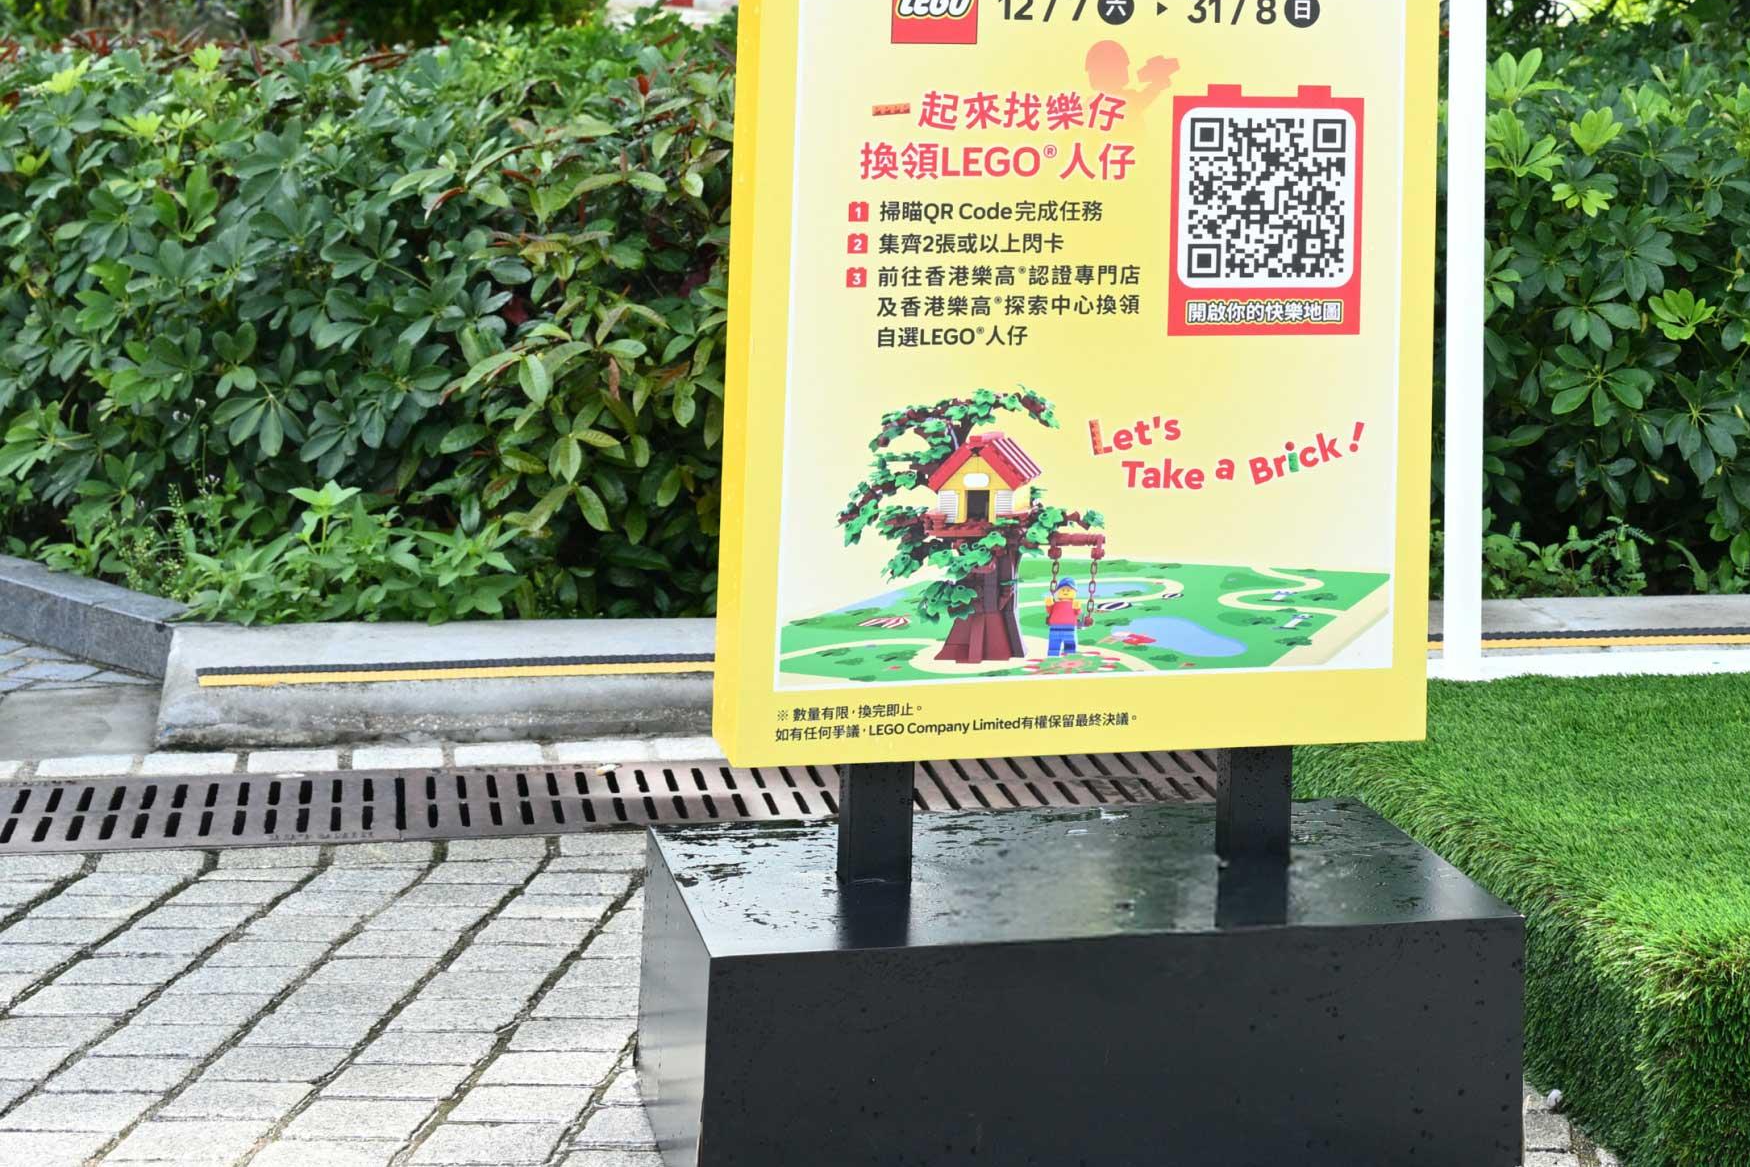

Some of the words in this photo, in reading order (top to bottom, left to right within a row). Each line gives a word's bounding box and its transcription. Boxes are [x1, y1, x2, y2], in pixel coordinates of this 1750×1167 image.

[879, 200, 954, 225] 掃瞄QR
[878, 232, 1065, 255] 集齊2張或以上閃卡
[1187, 301, 1343, 323] 開啟你的快樂地圖
[1089, 415, 1182, 455] Let's
[1121, 458, 1205, 490] Take
[1215, 458, 1236, 481] a
[907, 720, 970, 736] Company
